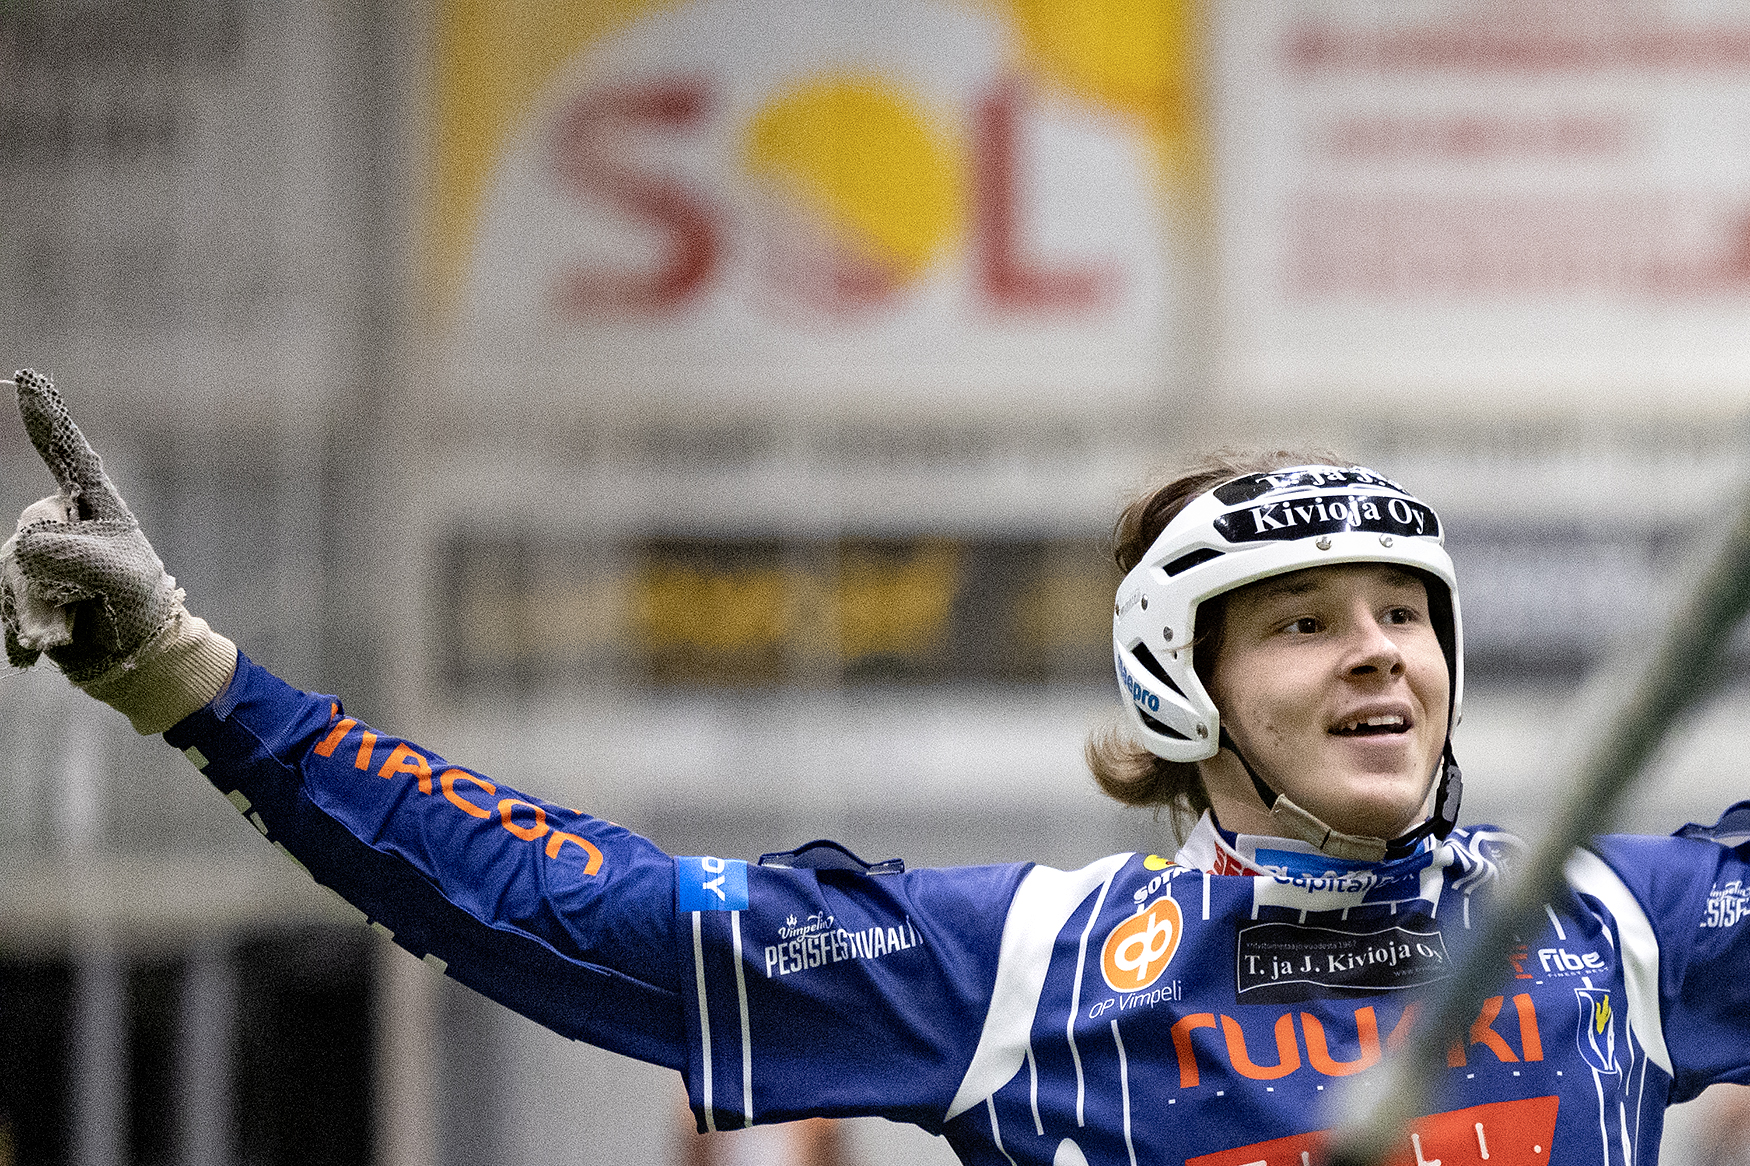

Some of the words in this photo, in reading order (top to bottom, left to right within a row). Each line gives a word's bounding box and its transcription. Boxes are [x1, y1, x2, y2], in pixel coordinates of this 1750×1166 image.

[1248, 496, 1382, 534] Kivioja
[1387, 499, 1425, 534] Oy
[1244, 954, 1265, 975] T.
[1270, 956, 1293, 980] ja
[1299, 955, 1320, 973] J.
[1327, 941, 1412, 974] Kivioja
[1088, 999, 1115, 1020] OP
[1119, 980, 1182, 1012] Vimpeli
